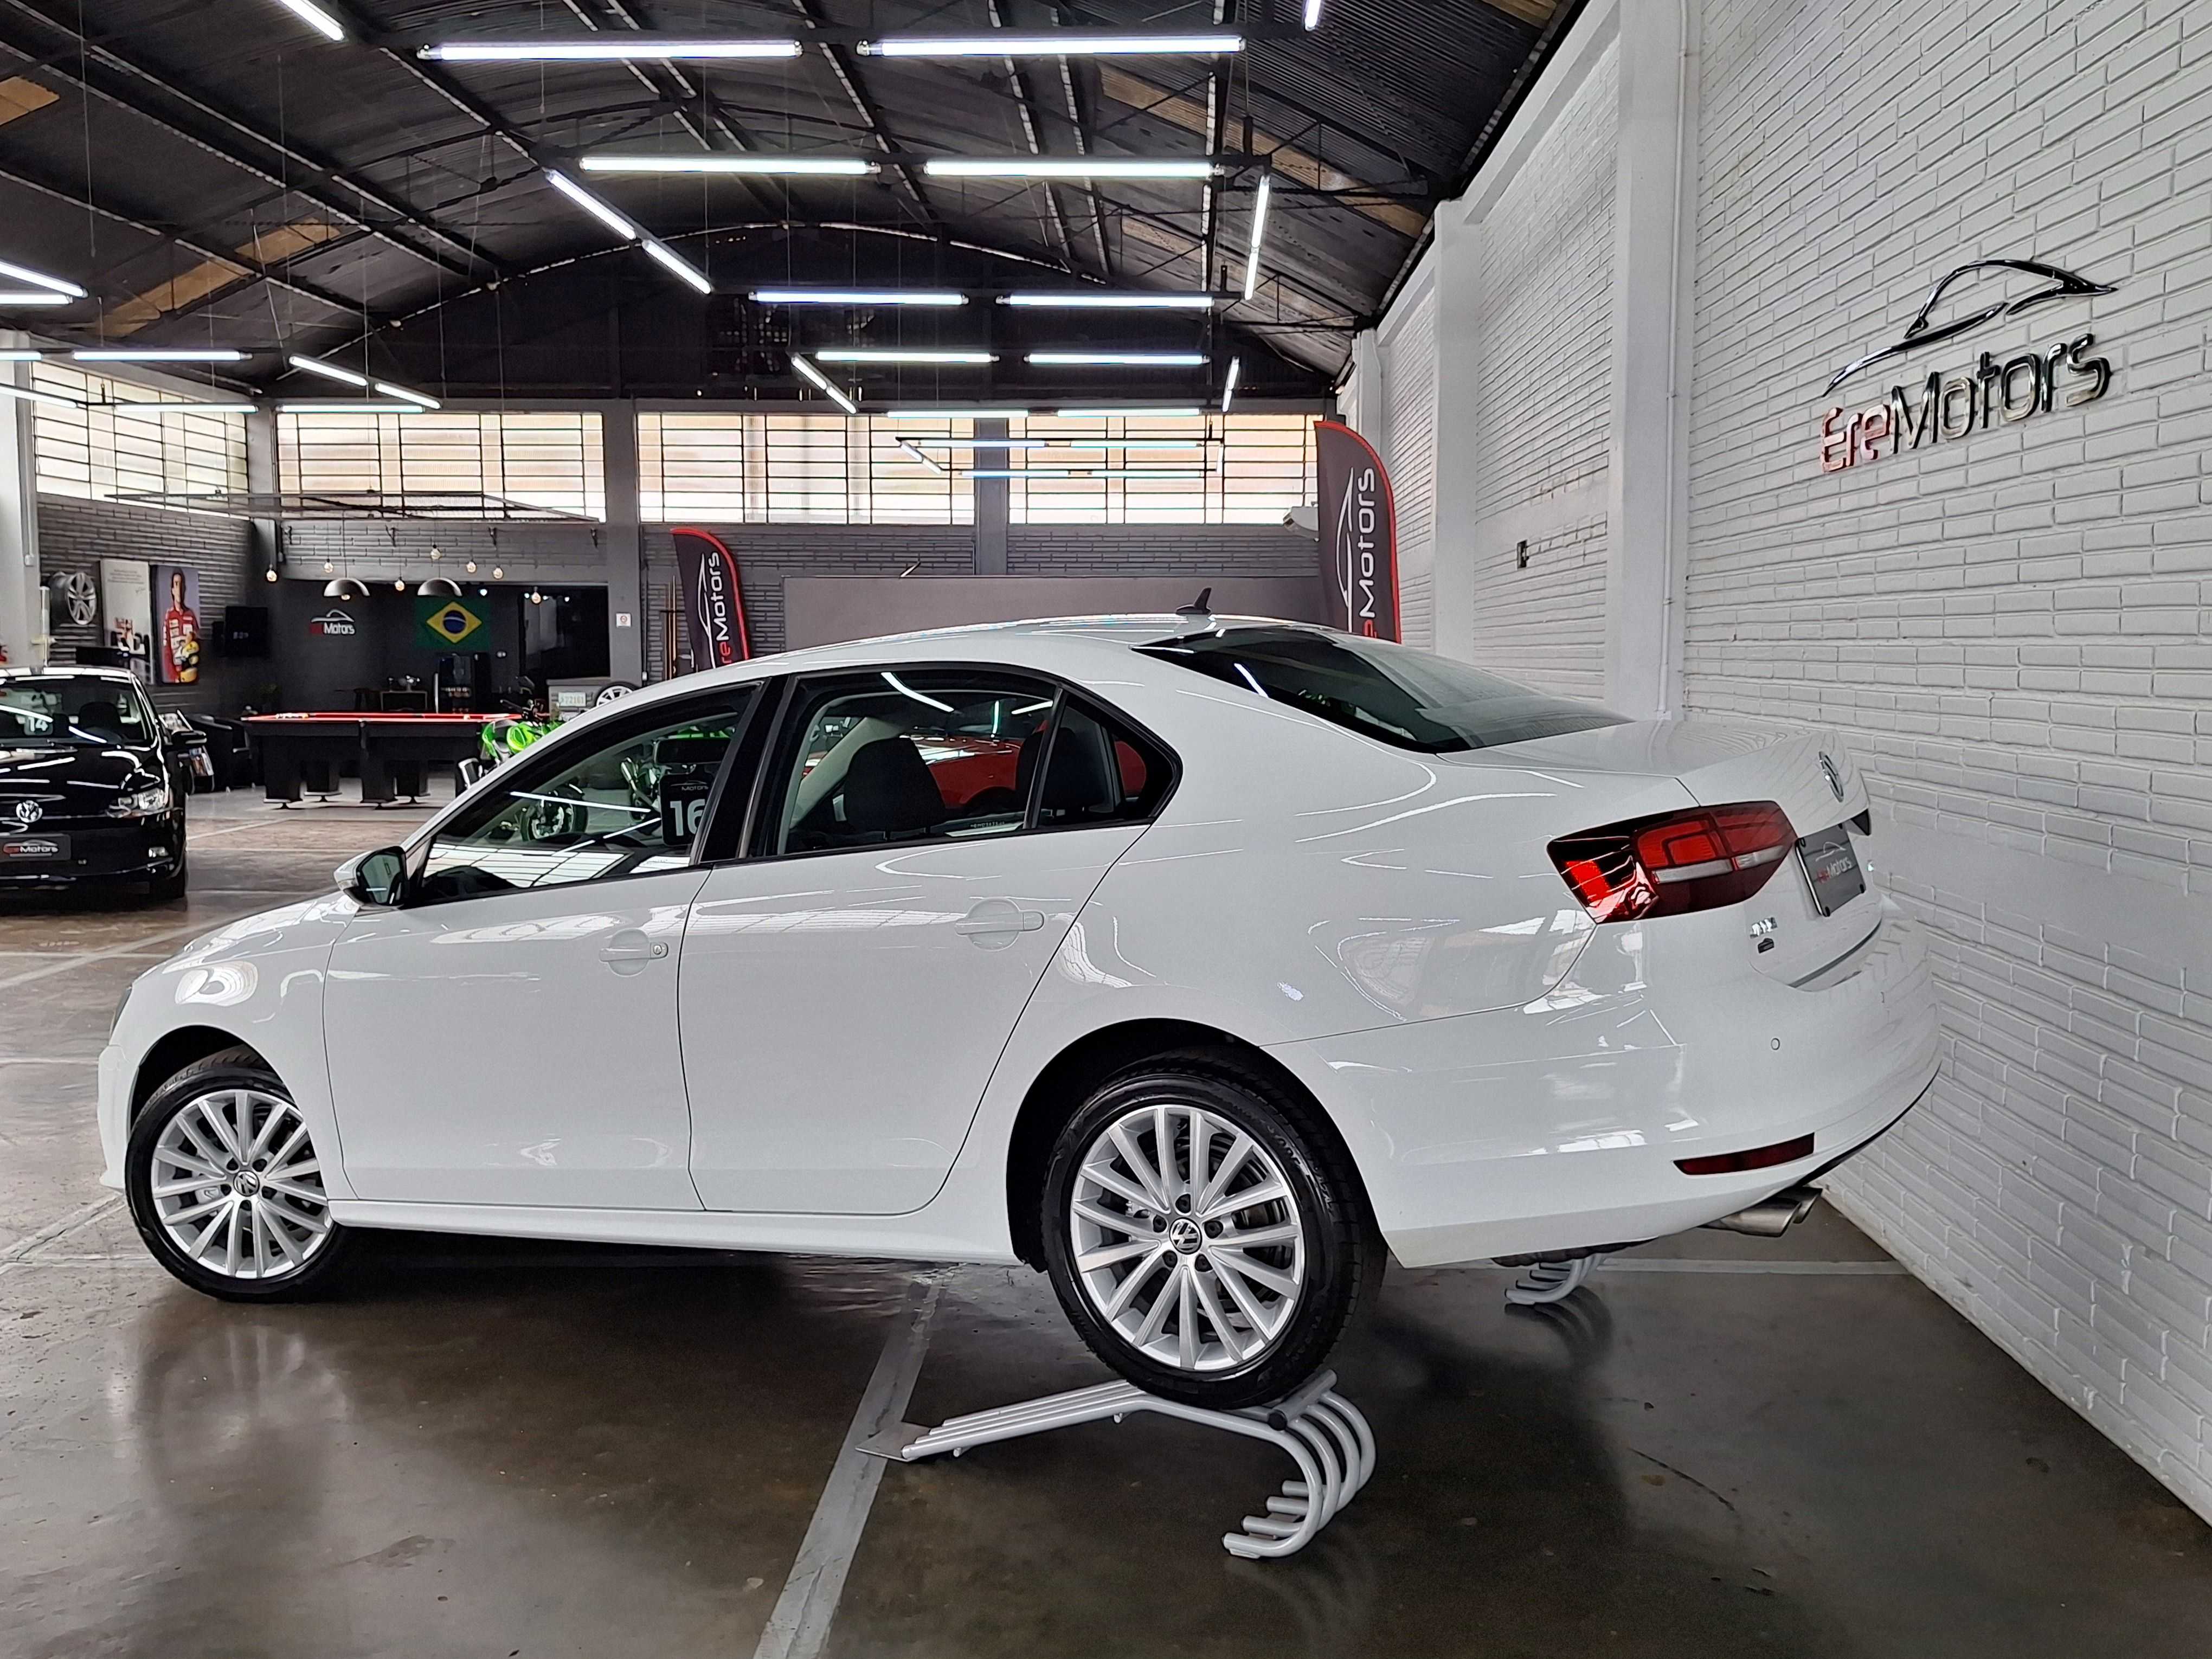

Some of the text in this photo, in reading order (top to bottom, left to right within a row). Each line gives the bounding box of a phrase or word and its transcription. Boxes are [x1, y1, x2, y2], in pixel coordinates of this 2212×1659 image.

[1358, 467, 1376, 638] eMotors
[310, 622, 355, 635] Motors
[708, 552, 732, 664] reMotors
[1817, 857, 1853, 884] Motors
